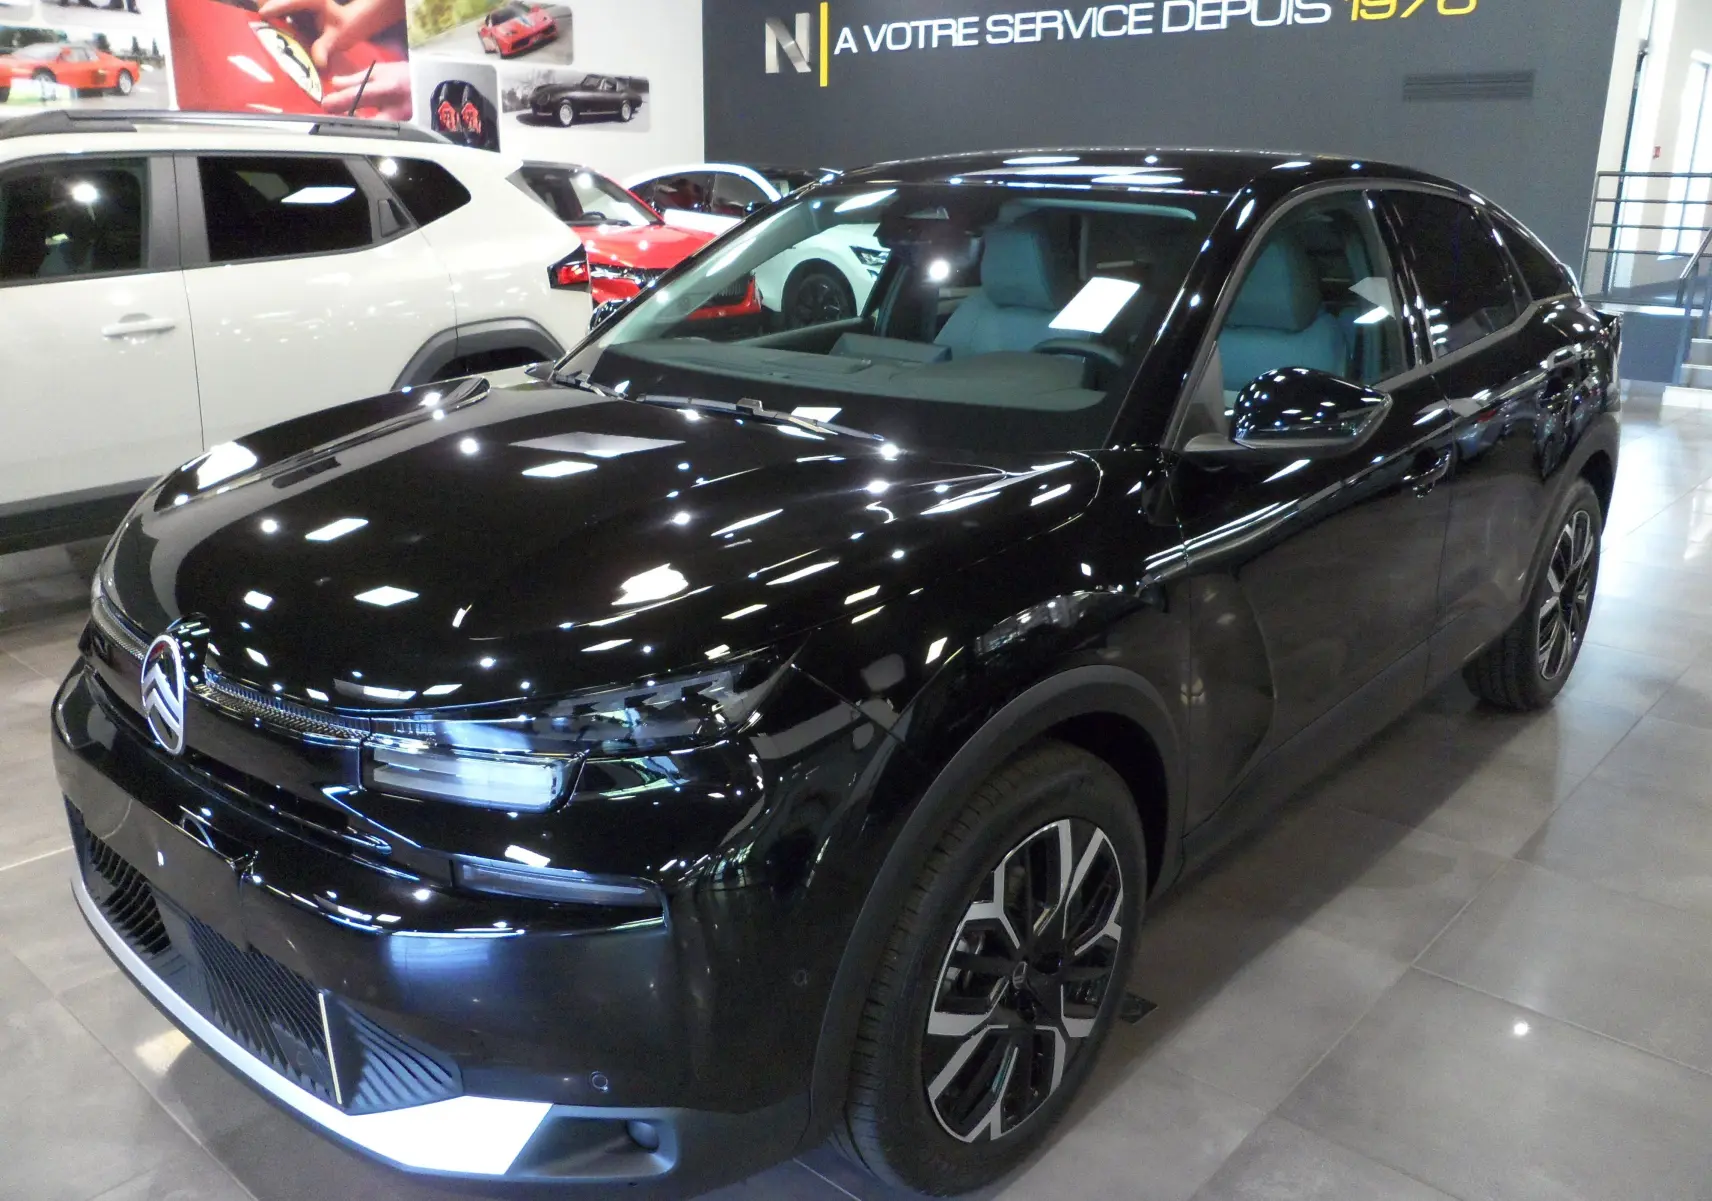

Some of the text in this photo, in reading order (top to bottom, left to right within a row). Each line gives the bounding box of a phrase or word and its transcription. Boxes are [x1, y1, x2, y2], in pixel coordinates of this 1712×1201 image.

[834, 27, 858, 55] A
[863, 16, 980, 52] VOTRE
[986, 1, 1153, 44] SERVICE
[1161, 0, 1332, 33] DEPUIS
